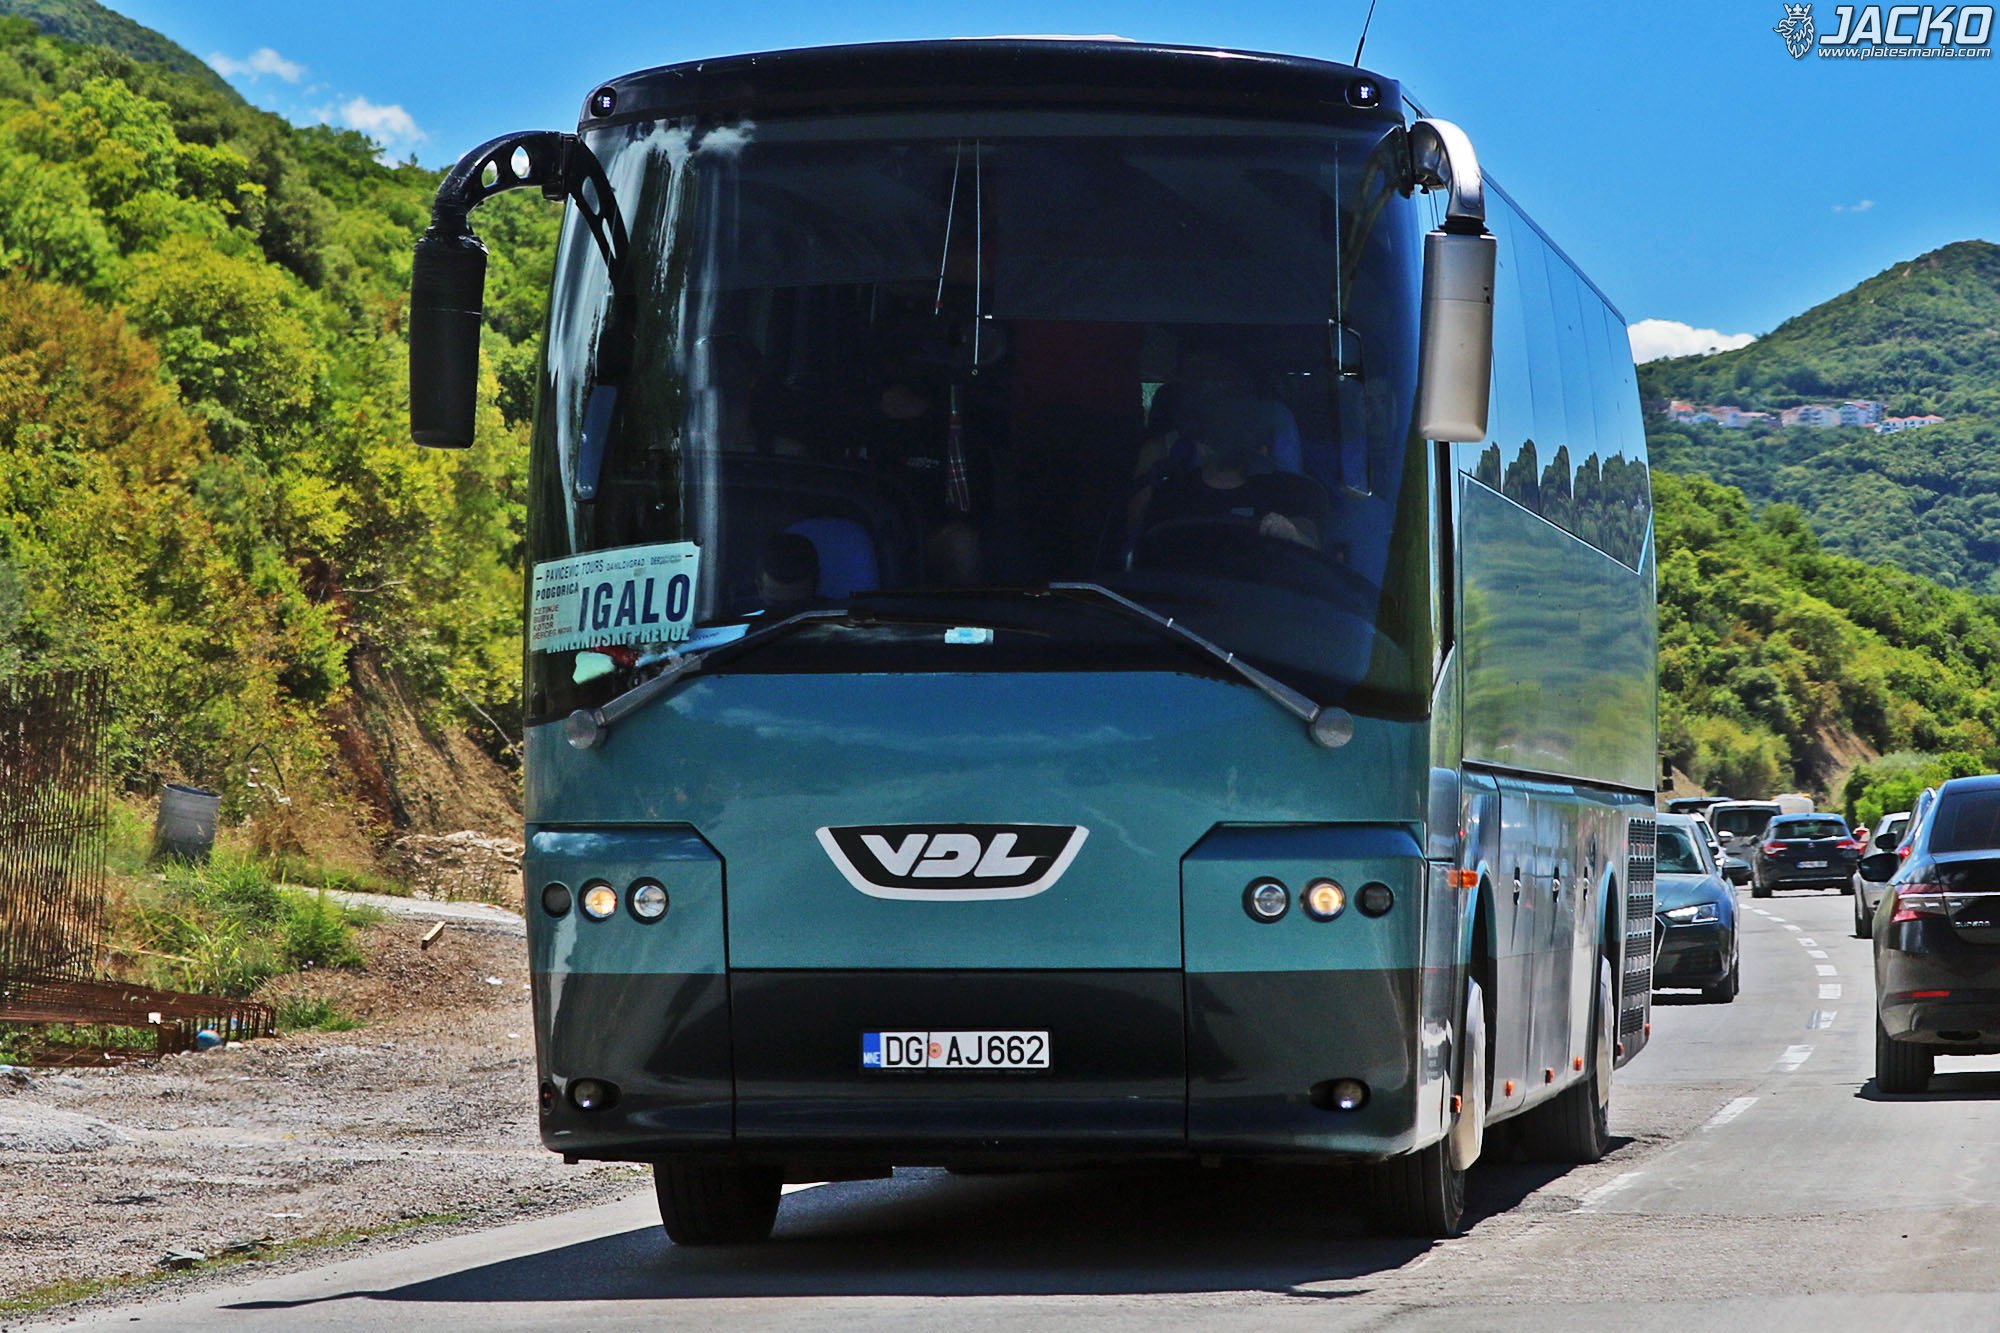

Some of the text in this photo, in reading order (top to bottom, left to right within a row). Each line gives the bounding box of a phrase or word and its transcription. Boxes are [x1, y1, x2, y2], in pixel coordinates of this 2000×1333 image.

[535, 582, 579, 601] PODGORICA
[578, 573, 691, 634] IGALO
[533, 621, 554, 632] KOTOR
[860, 833, 1036, 878] VDL
[885, 1035, 1045, 1066] DG AJ662
